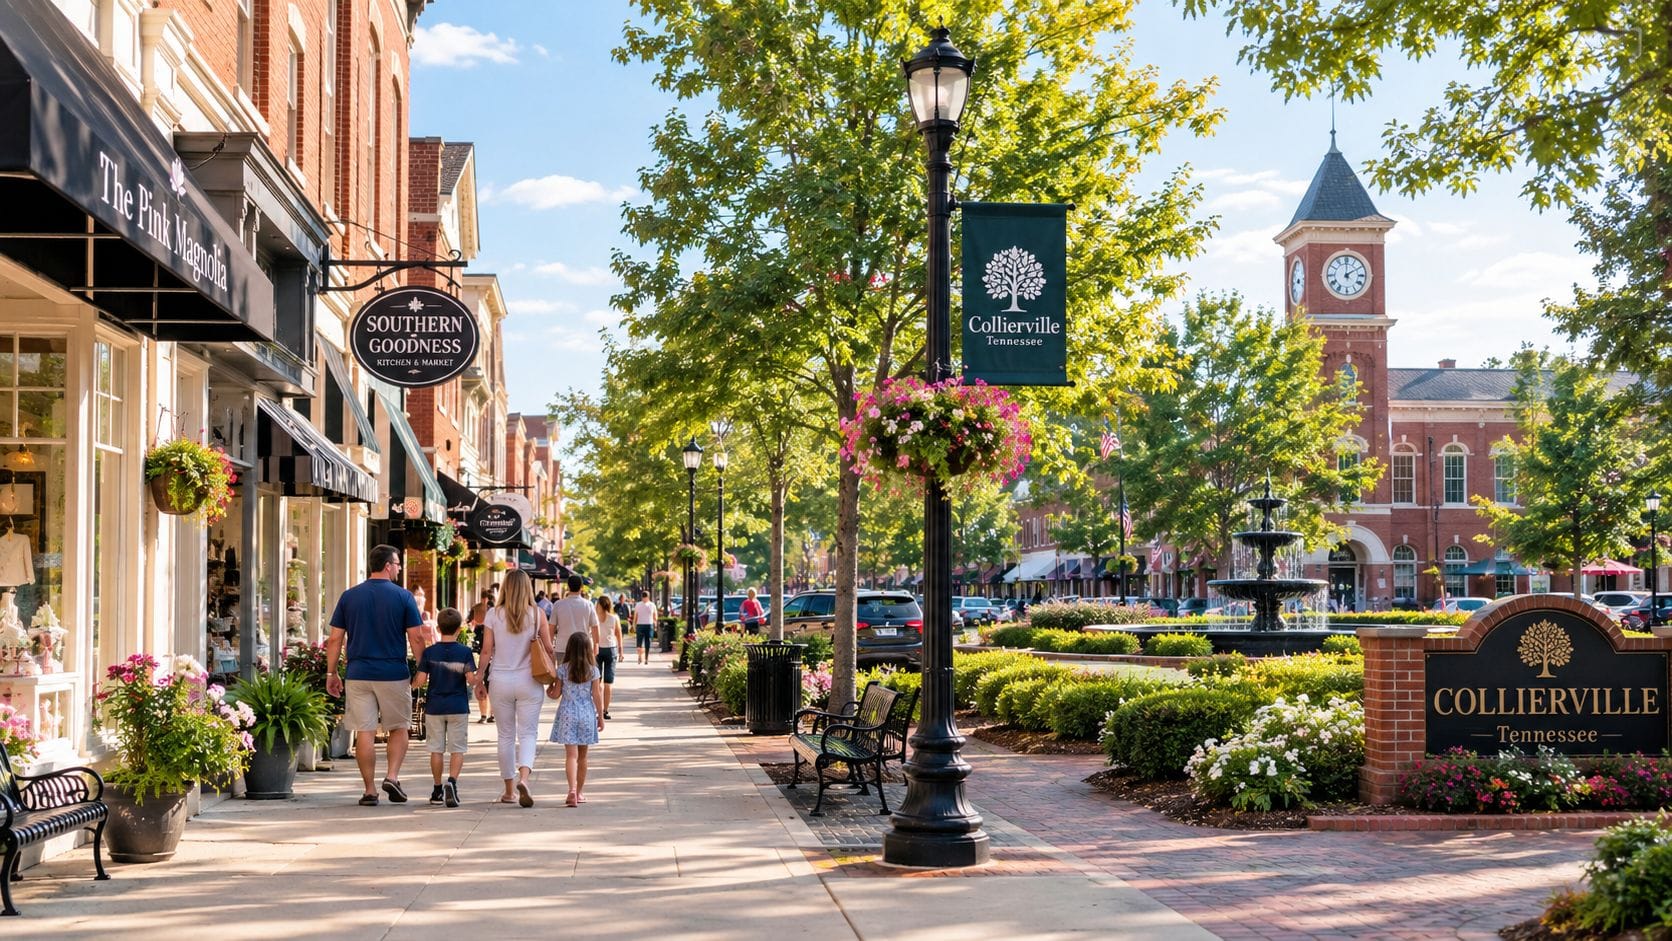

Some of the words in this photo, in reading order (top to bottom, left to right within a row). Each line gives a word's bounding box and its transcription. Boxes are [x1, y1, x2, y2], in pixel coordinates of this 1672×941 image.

[100, 151, 133, 220] The
[137, 183, 172, 250] Pink
[174, 213, 228, 292] Magnolia
[366, 315, 464, 333] SOUTHERN
[968, 315, 1060, 334] Collierville
[369, 338, 462, 354] GOODNESS
[986, 335, 1043, 346] Tennessee
[376, 359, 411, 367] KITCHEN
[422, 359, 454, 367] MARKET
[1433, 687, 1660, 716] COLLIERVILLE
[1496, 725, 1598, 743] Tennessee
